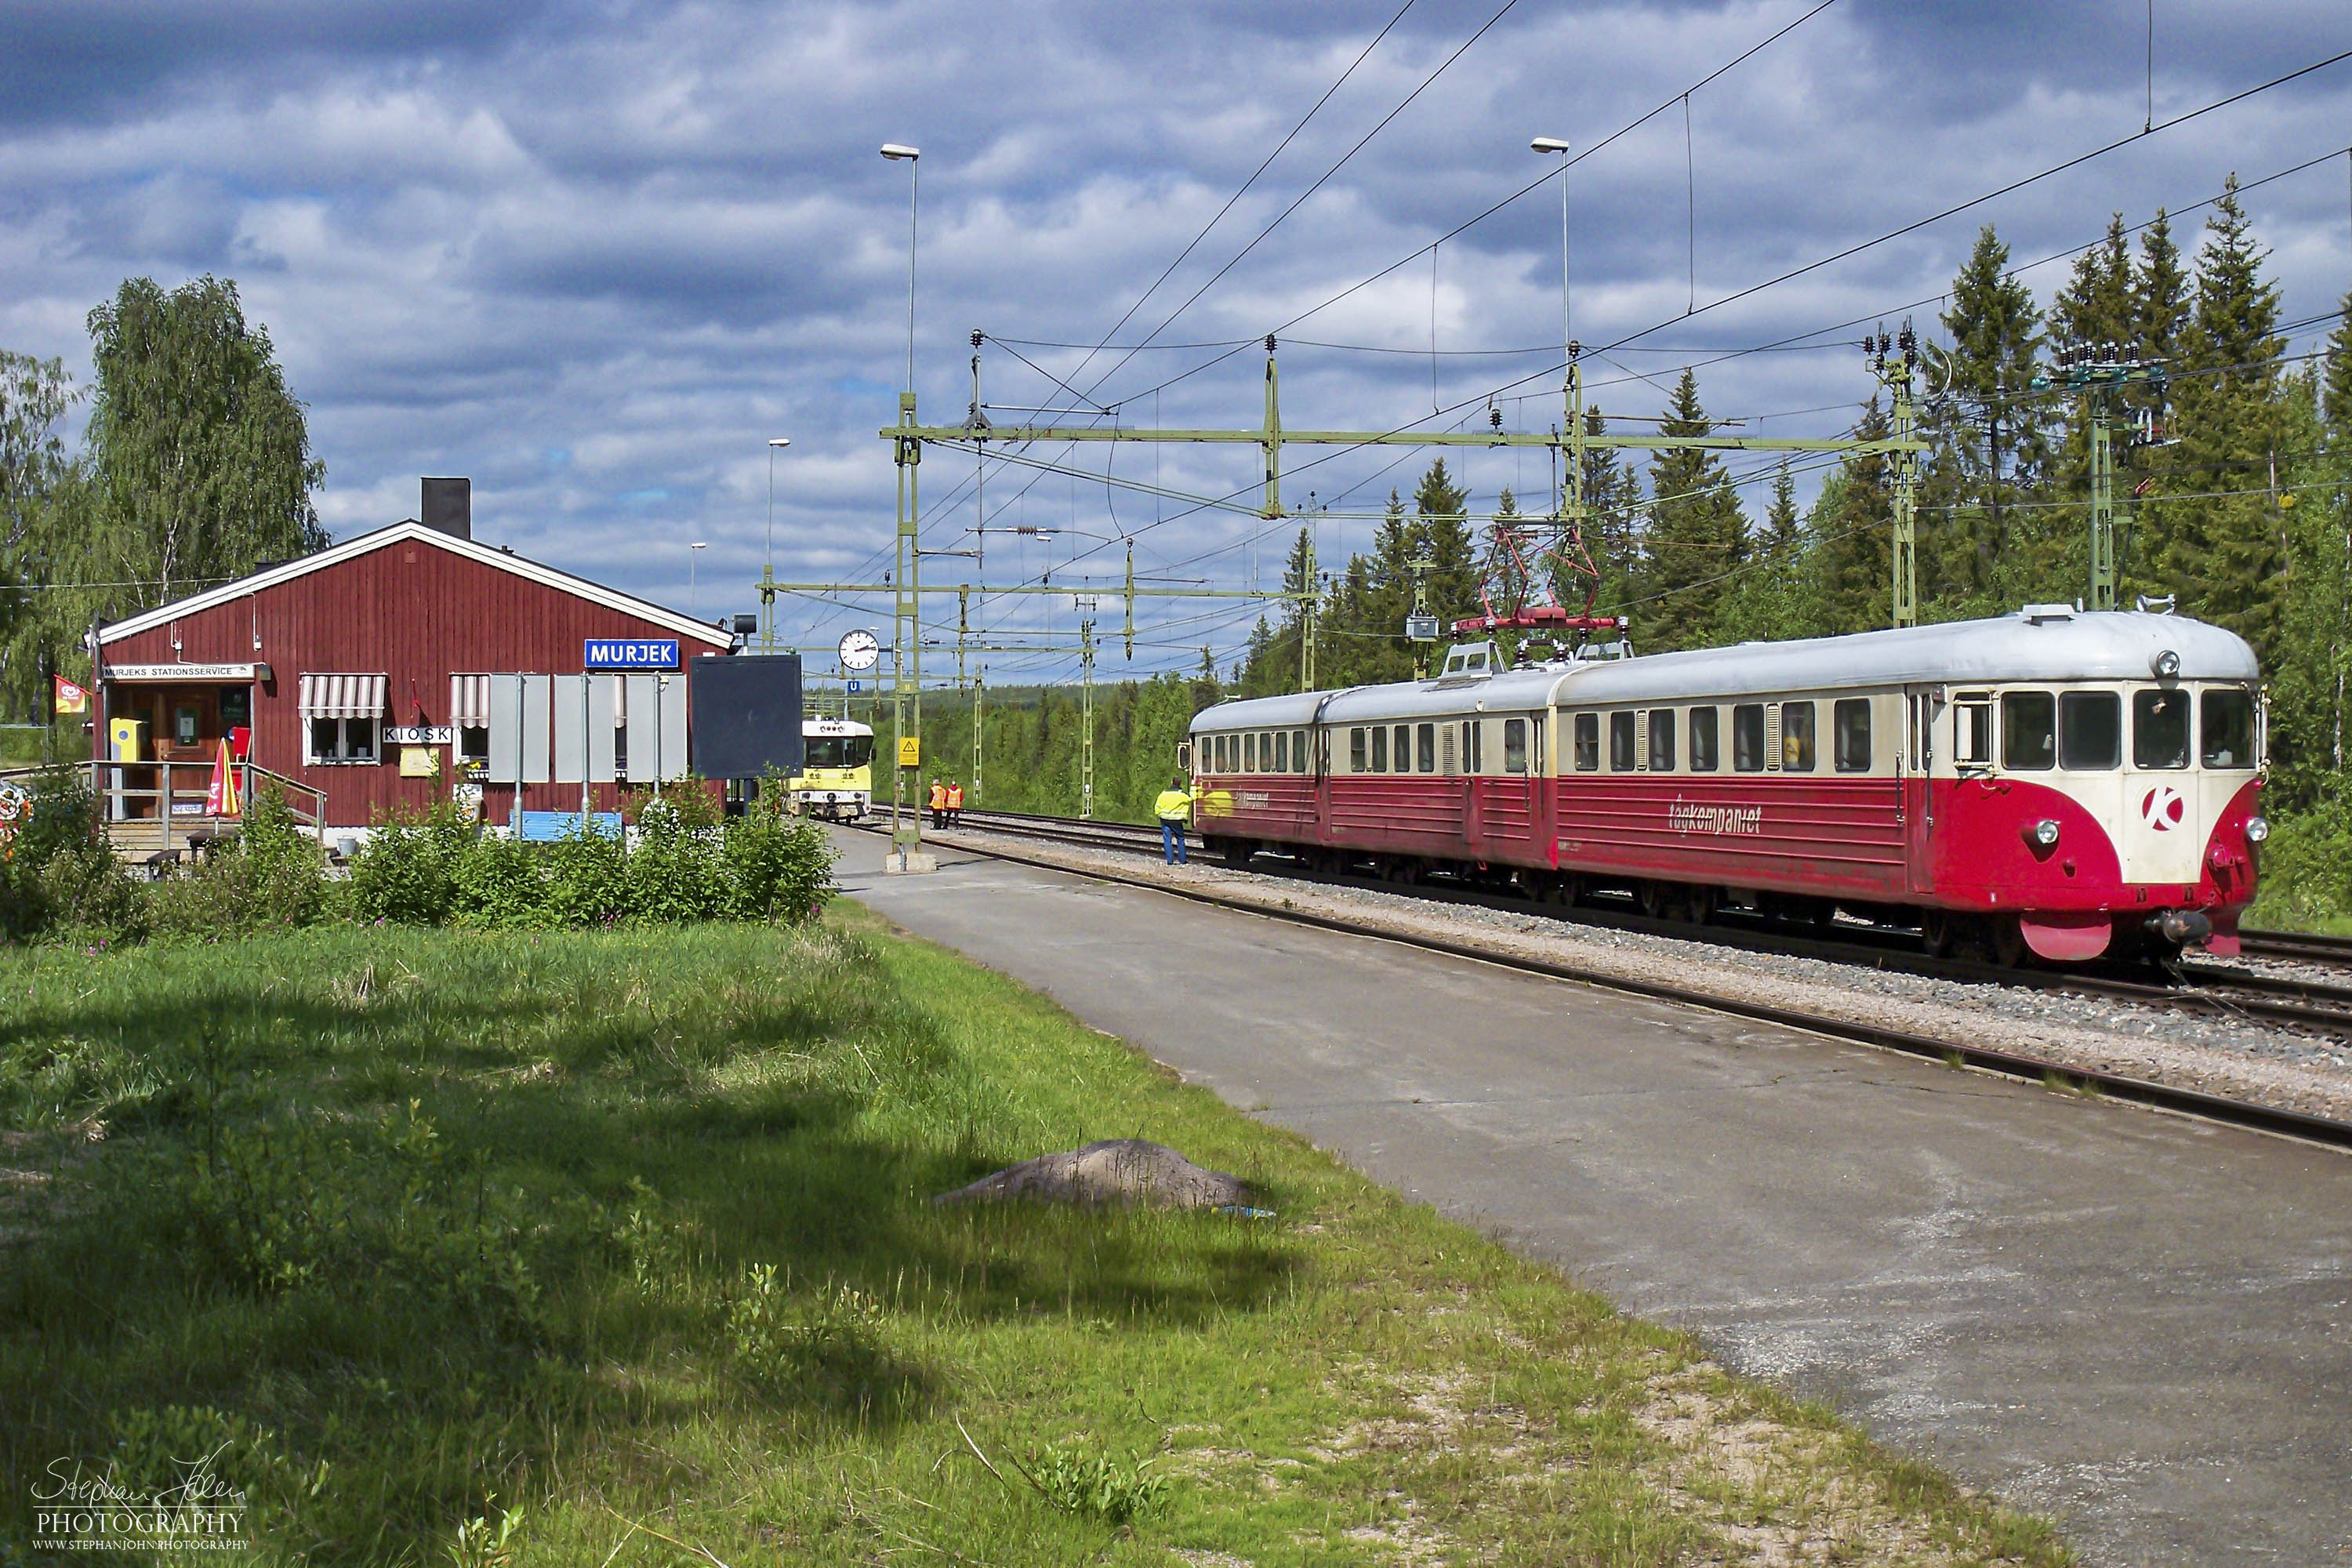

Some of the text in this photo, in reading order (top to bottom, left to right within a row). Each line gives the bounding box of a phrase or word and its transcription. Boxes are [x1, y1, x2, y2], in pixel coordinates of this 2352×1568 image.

[590, 645, 672, 662] MURJEK
[105, 667, 232, 677] MURJEKS STATIONSSERVICE
[850, 682, 858, 691] U
[384, 728, 448, 741] KIOSK
[1668, 793, 1762, 837] tågkompaniet
